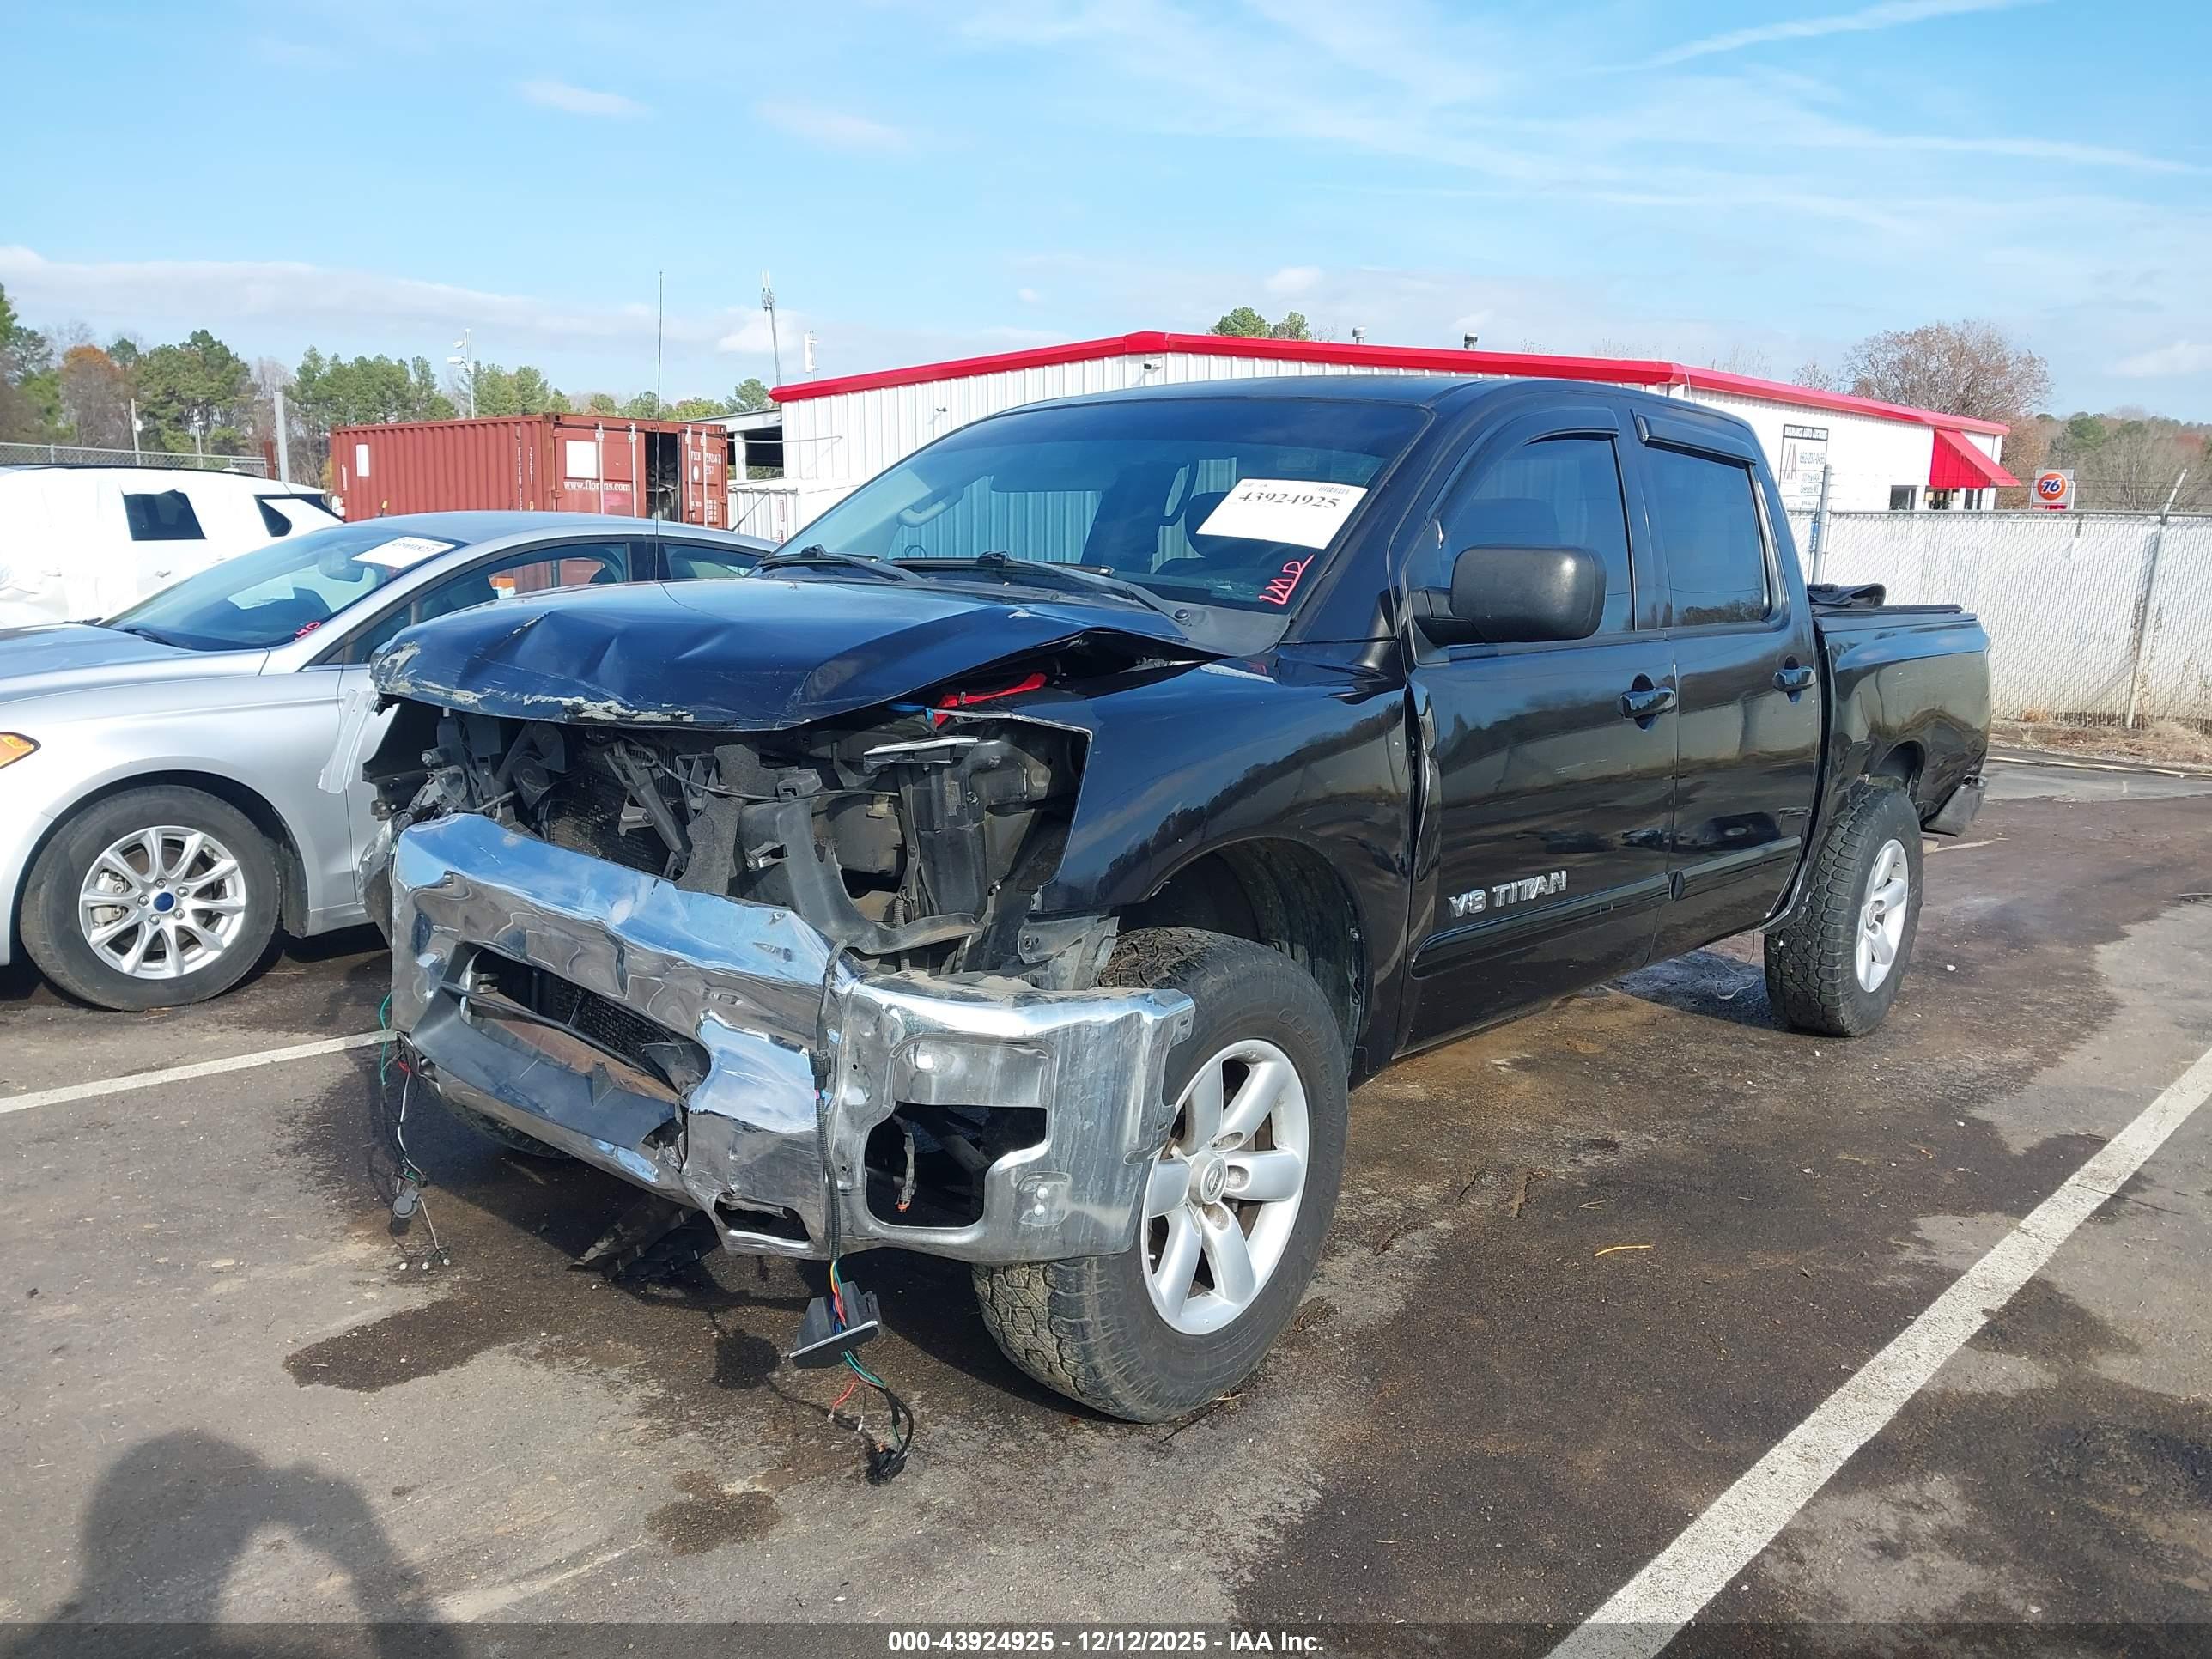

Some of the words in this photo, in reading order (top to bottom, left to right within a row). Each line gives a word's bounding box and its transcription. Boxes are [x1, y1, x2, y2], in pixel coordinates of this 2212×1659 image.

[563, 480, 631, 492] www.florns.com
[2040, 478, 2062, 494] 76
[1238, 491, 1340, 508] 43924925
[1448, 889, 1486, 918] V8
[1491, 870, 1567, 908] TITAN
